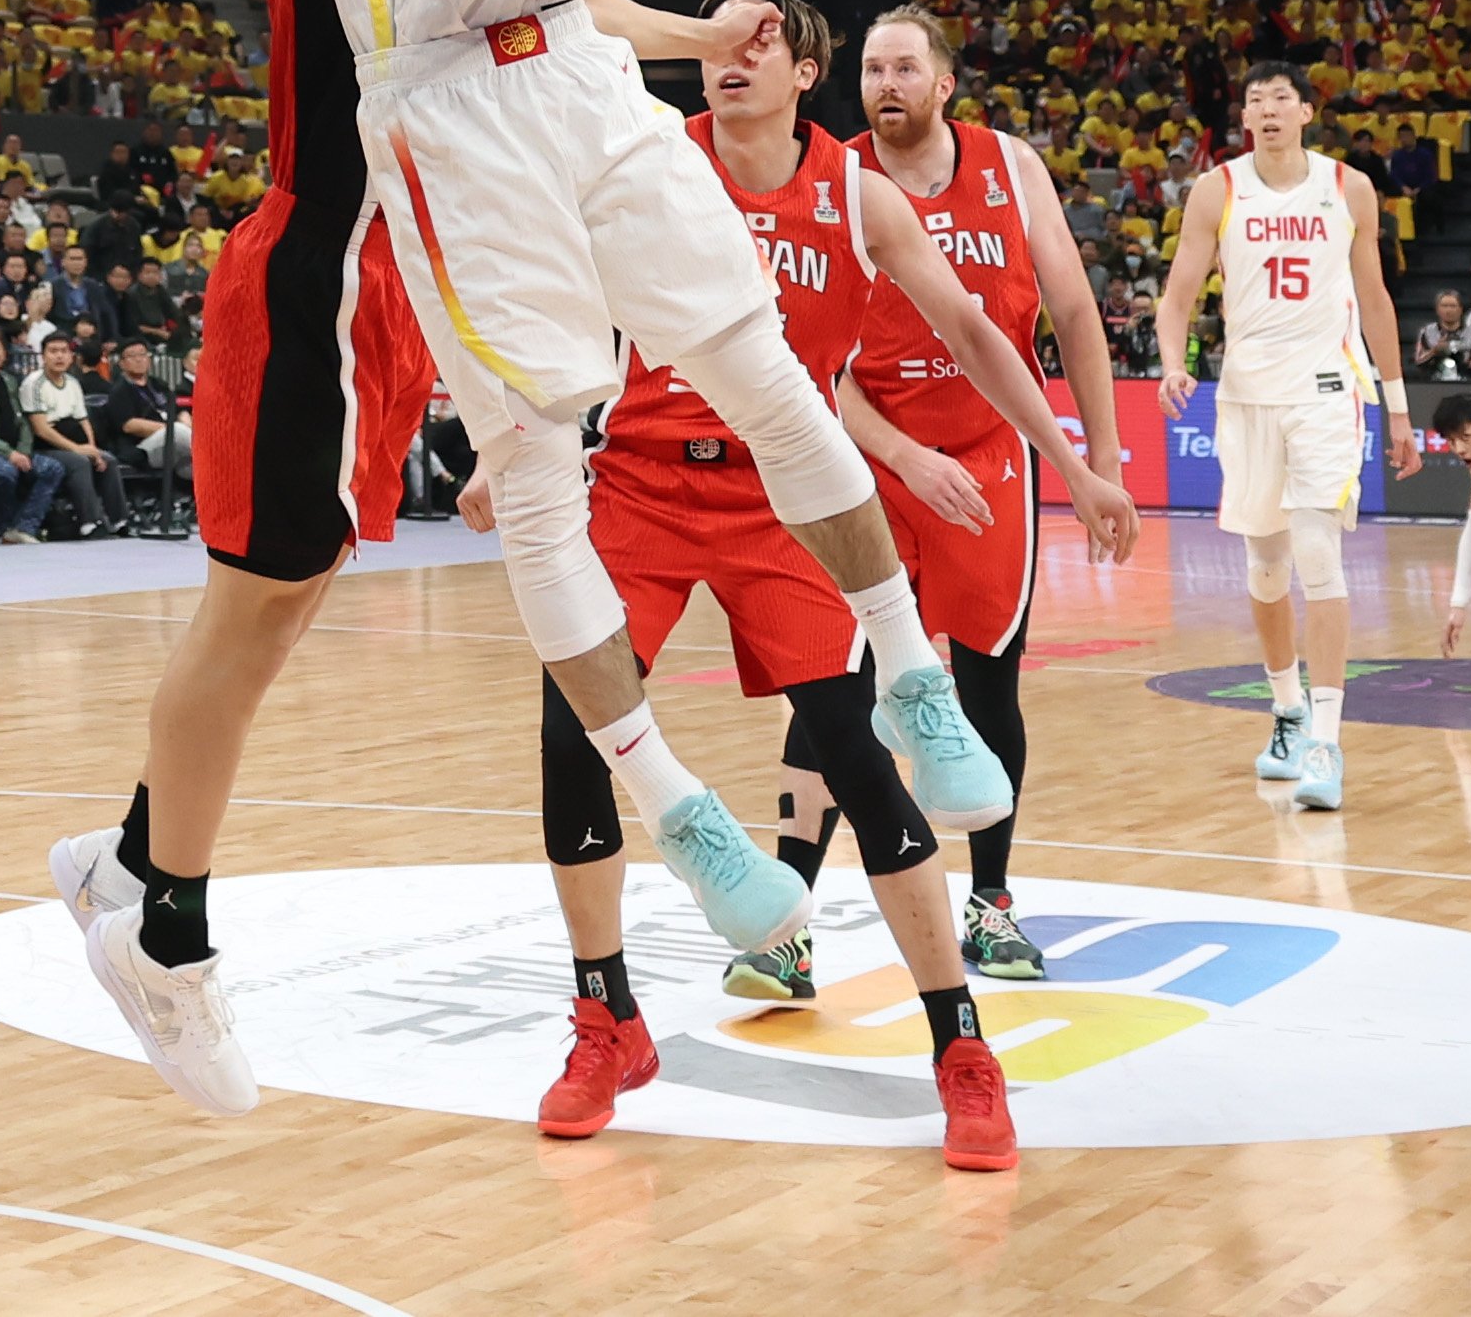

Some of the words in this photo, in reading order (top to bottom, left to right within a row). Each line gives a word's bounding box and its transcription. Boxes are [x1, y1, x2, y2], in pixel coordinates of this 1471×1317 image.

[930, 229, 1006, 269] PAN
[1245, 215, 1328, 243] CHINA
[1262, 255, 1311, 301] 15
